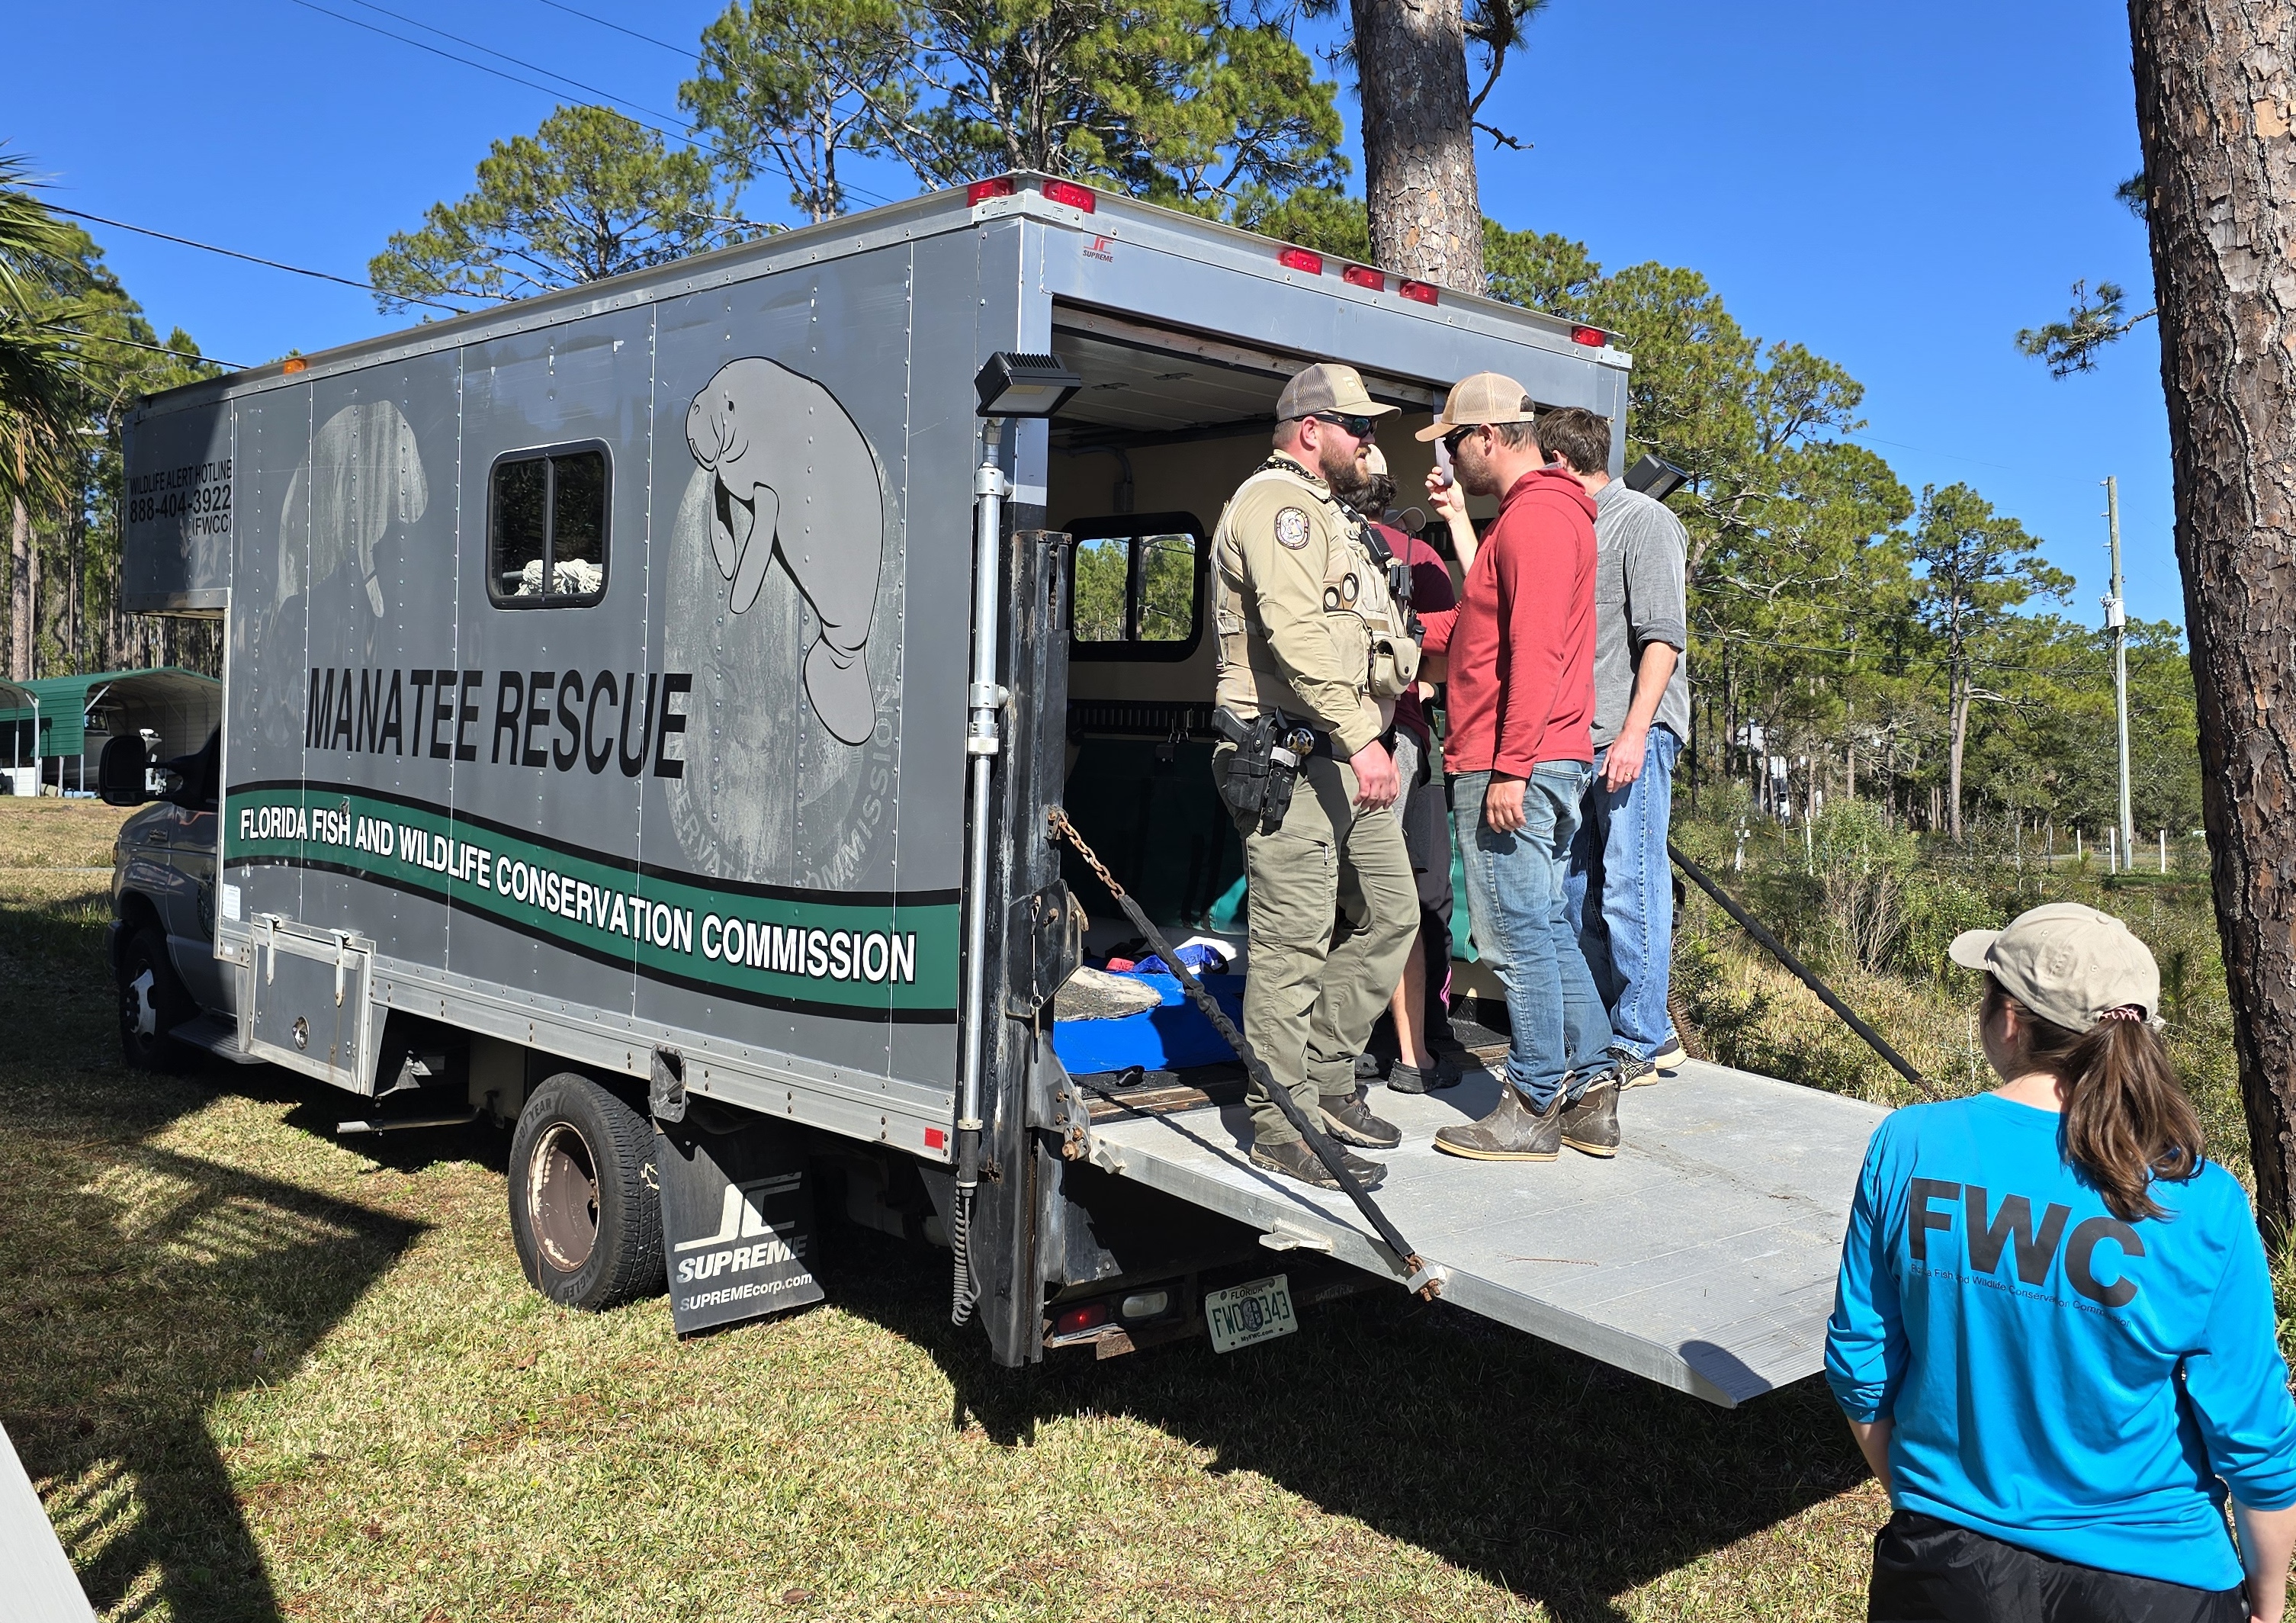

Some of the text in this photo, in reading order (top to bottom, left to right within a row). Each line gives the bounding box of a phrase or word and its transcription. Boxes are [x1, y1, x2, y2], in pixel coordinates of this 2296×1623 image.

[1083, 249, 1114, 263] SUPREME
[130, 459, 232, 496] WILDLIFE ALERT HOTLINE
[130, 484, 231, 523] 888-404-3922
[305, 668, 692, 779] MANATEE RESCUE
[240, 807, 915, 982] FLORIDA FISH AND WILDLIFE CONSERVATION COMMISSION
[676, 1234, 808, 1283] SUPREME
[1908, 1177, 2146, 1308] FWC
[679, 1273, 813, 1311] SUPREMEcorp.com
[1935, 1268, 1954, 1280] Fish
[1973, 1276, 2006, 1290] Wildlife
[2009, 1285, 2070, 1307] Conservaon
[2073, 1300, 2132, 1328] Commssion
[1241, 1329, 1274, 1342] MyFWC.com
